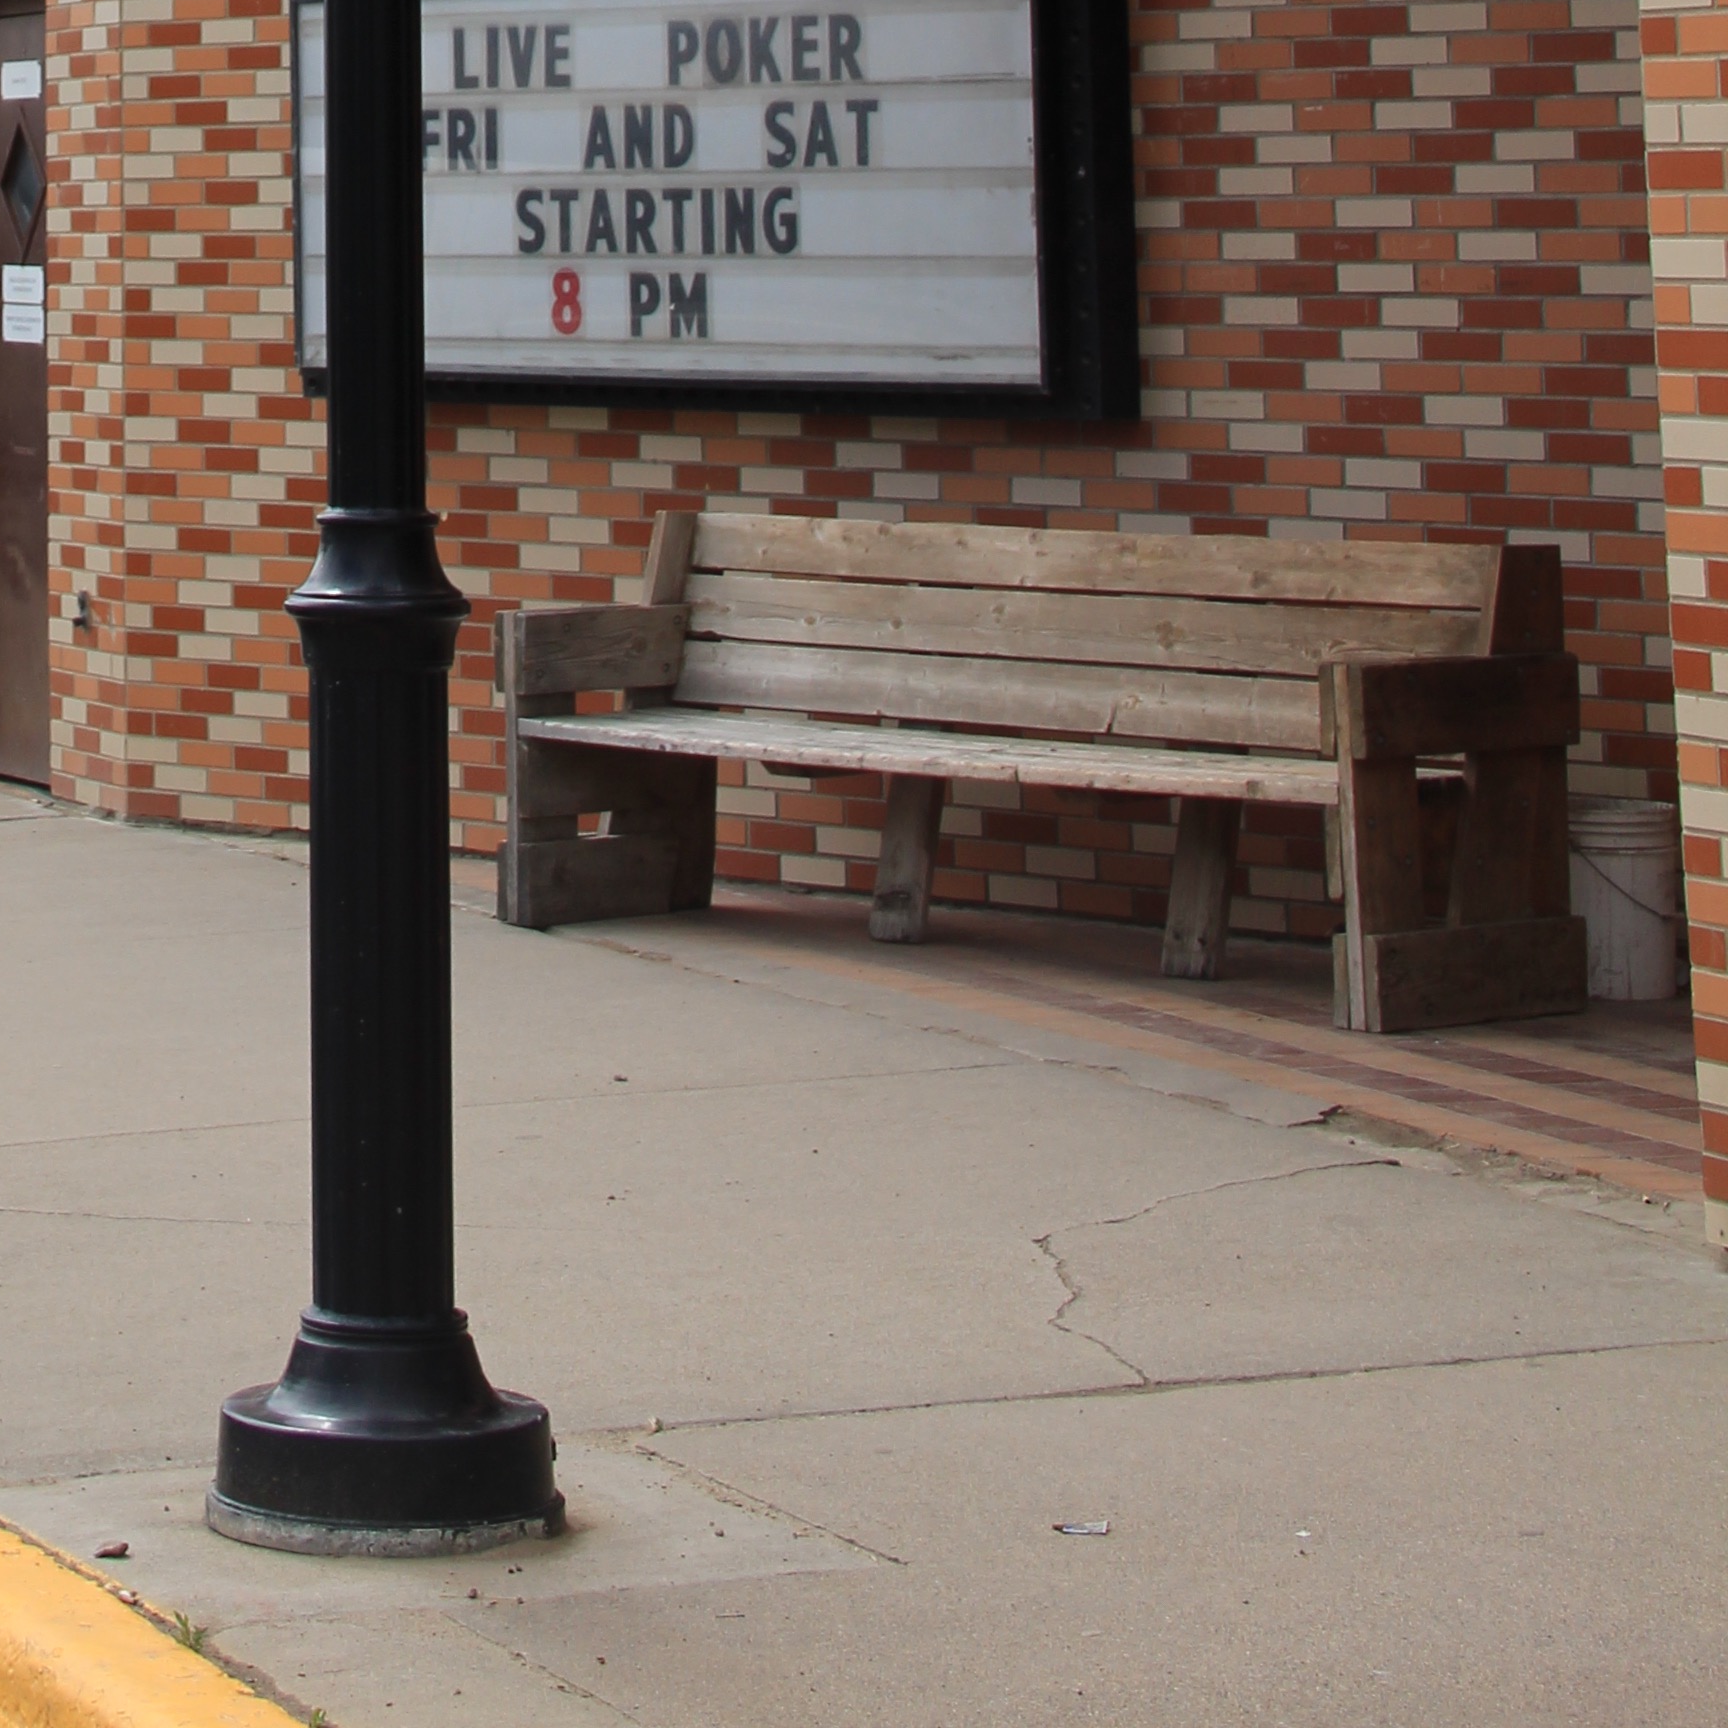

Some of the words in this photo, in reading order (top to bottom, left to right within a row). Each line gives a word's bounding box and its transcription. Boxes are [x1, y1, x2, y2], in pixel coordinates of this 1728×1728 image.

[452, 23, 571, 89] LIVE
[667, 12, 864, 87] POKER
[422, 106, 500, 173] FRI
[583, 102, 696, 170] AND
[764, 98, 879, 169] SAT
[515, 186, 799, 255] STARTING
[550, 266, 583, 336] 8
[629, 271, 709, 339] PM
